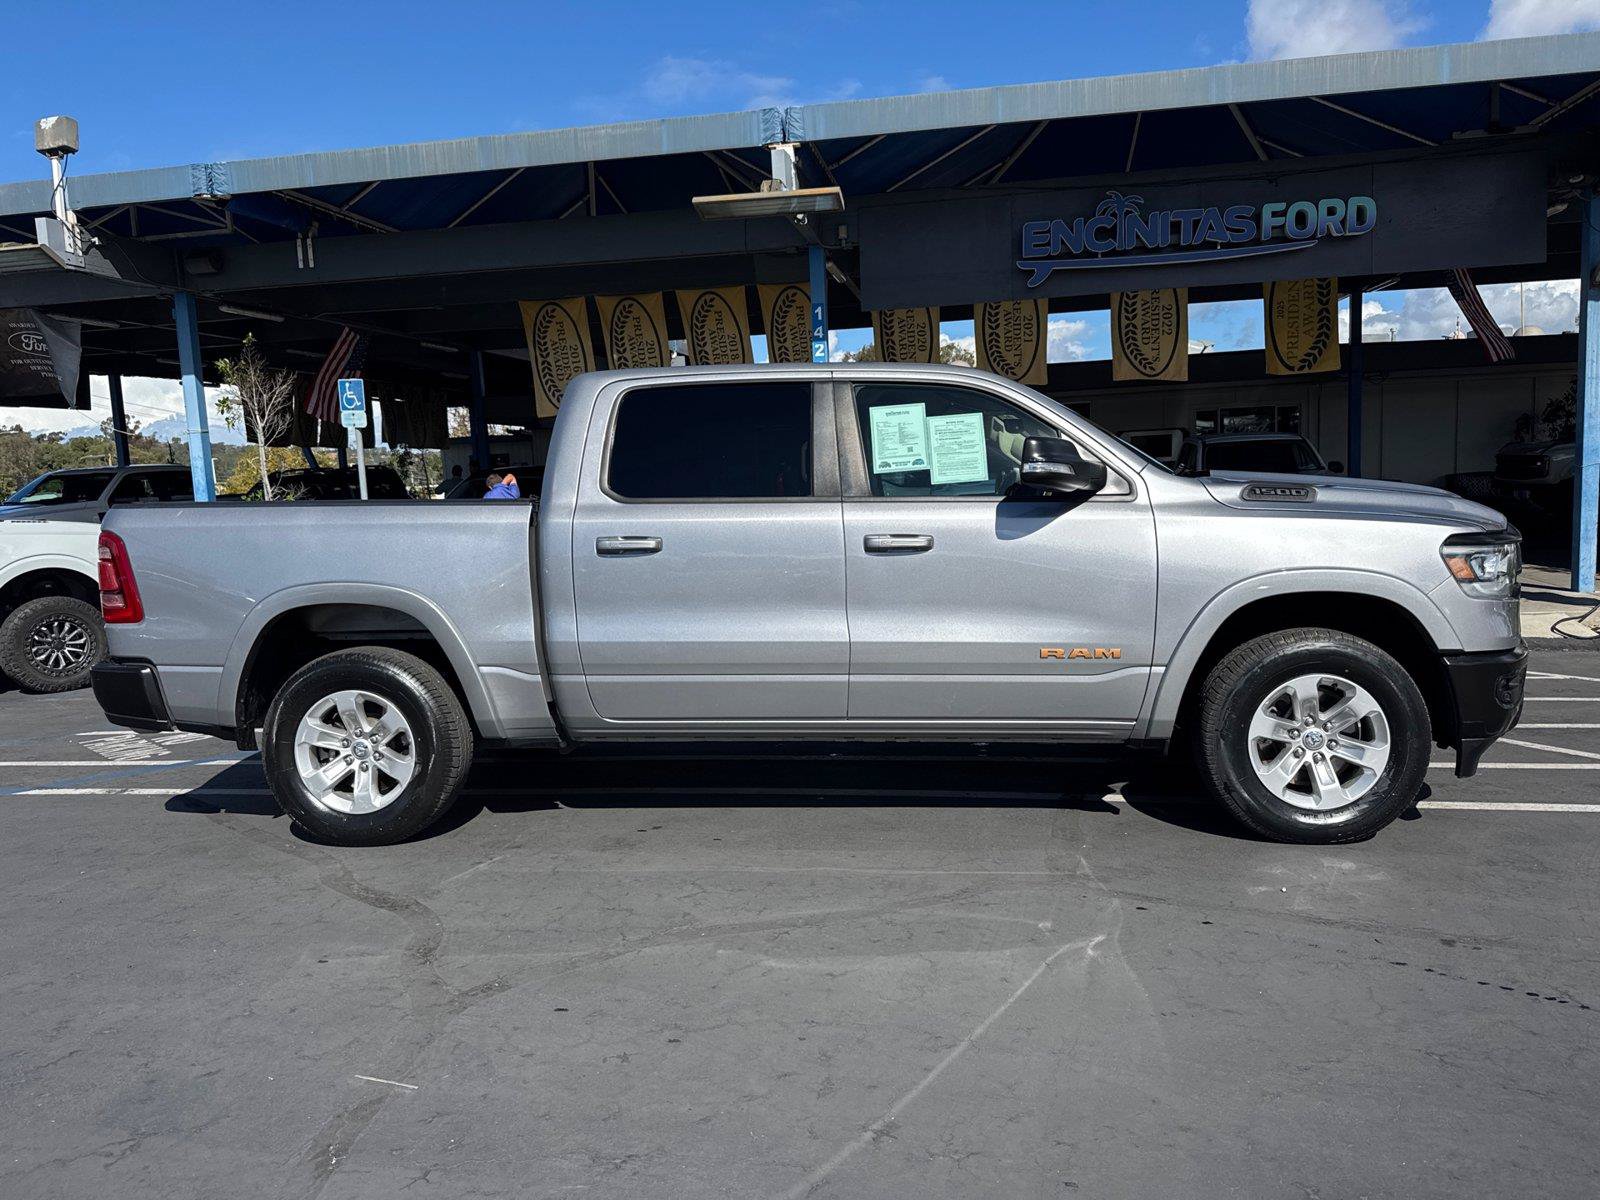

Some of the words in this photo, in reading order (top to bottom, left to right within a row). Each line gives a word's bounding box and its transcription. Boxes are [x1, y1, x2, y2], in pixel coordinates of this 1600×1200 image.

[1022, 200, 1257, 258] ENCINITAS
[1261, 195, 1377, 241] FORD
[632, 316, 647, 368] PRESIDE
[714, 310, 730, 365] PRESIDE
[796, 304, 810, 363] PRESIDE
[897, 316, 908, 361] AWARD
[905, 308, 917, 362] RESIDEN
[917, 321, 928, 352] 2020
[1003, 309, 1013, 353] AWARD
[1012, 299, 1022, 368] RESIDENT'S
[1023, 314, 1034, 343] 2021
[1141, 298, 1151, 346] AWARD
[1150, 288, 1161, 363] RESIDENT'S
[1161, 304, 1173, 336] 2022
[1286, 281, 1300, 360] PRESIDEN
[21, 334, 48, 351] For
[549, 338, 565, 382] AWARD
[569, 344, 582, 373] 2016
[627, 334, 639, 368] AWAR
[726, 333, 740, 361] 2018
[1250, 487, 1307, 496] 1500
[1039, 647, 1121, 660] RAM
